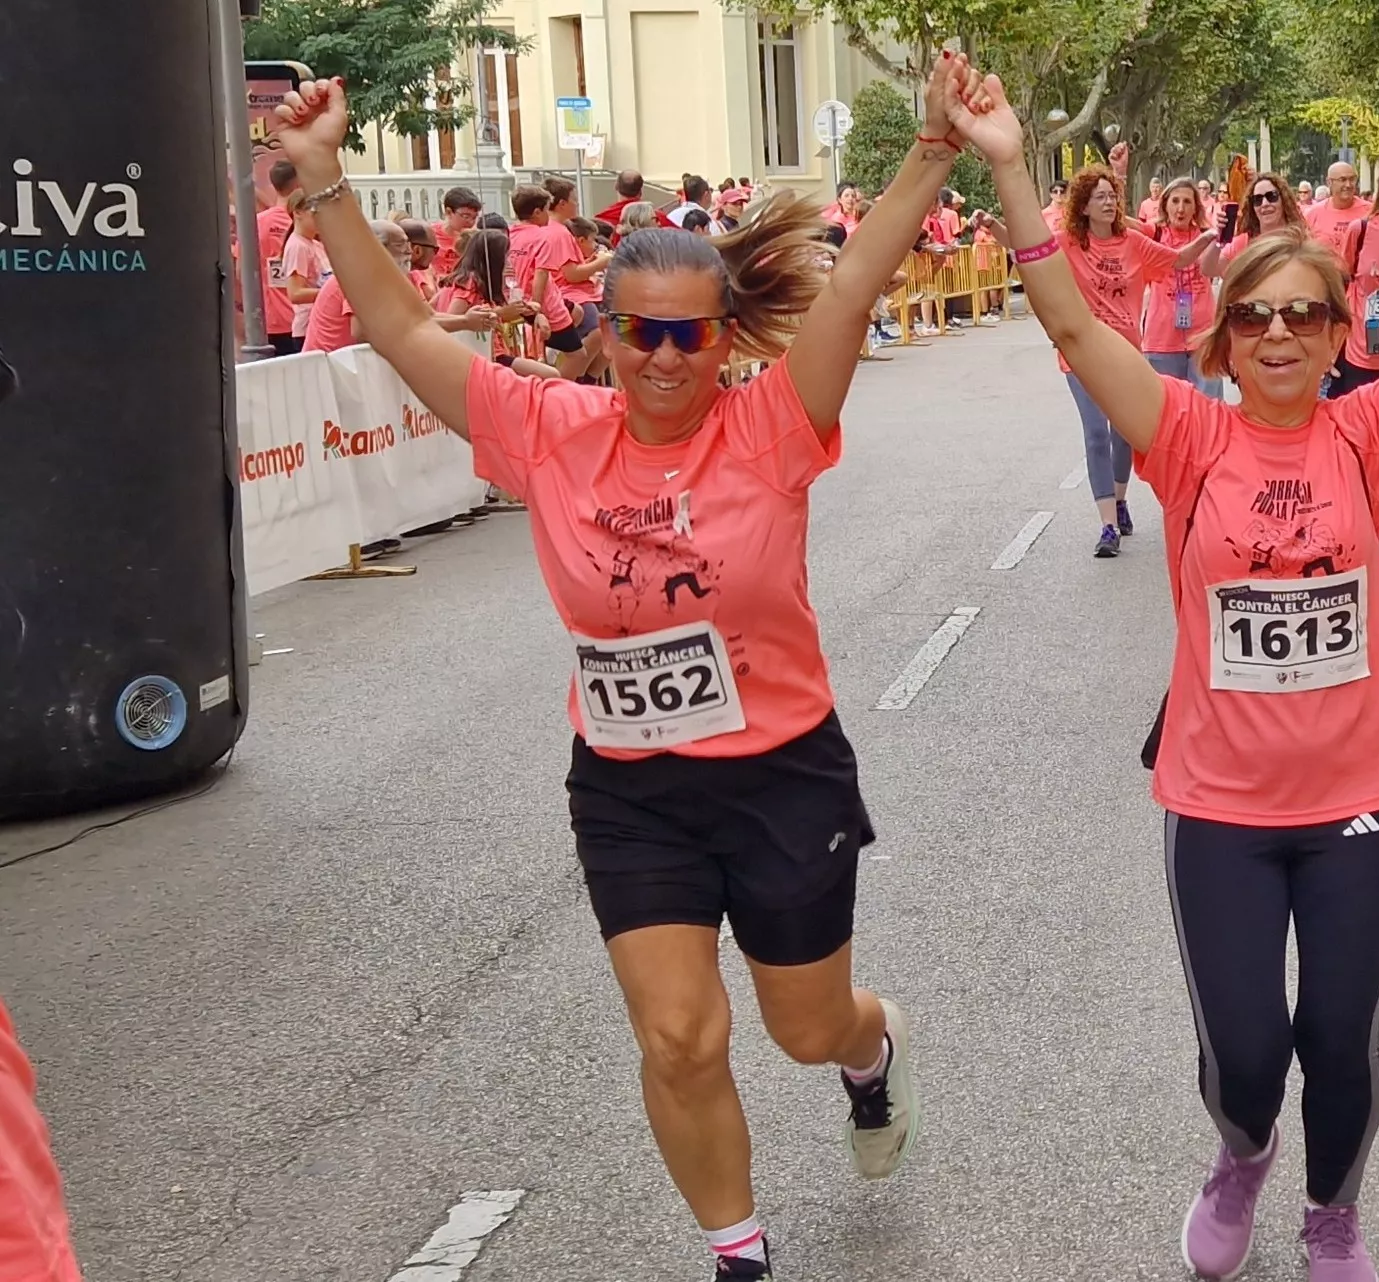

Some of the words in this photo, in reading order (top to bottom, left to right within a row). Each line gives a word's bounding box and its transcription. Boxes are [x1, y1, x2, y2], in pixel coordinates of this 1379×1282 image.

[323, 419, 395, 461] Aampo
[402, 403, 450, 442] Alcam
[238, 442, 305, 483] lcampo
[1228, 599, 1283, 614] CONTRA
[1285, 602, 1300, 613] EL
[1302, 593, 1353, 612] CÁNCER
[1271, 592, 1311, 602] HUESCA
[1229, 610, 1354, 661] 1613
[582, 657, 630, 673] CONTRA
[631, 657, 649, 669] EL
[649, 644, 707, 668] CÁNCER
[588, 665, 721, 717] 1562
